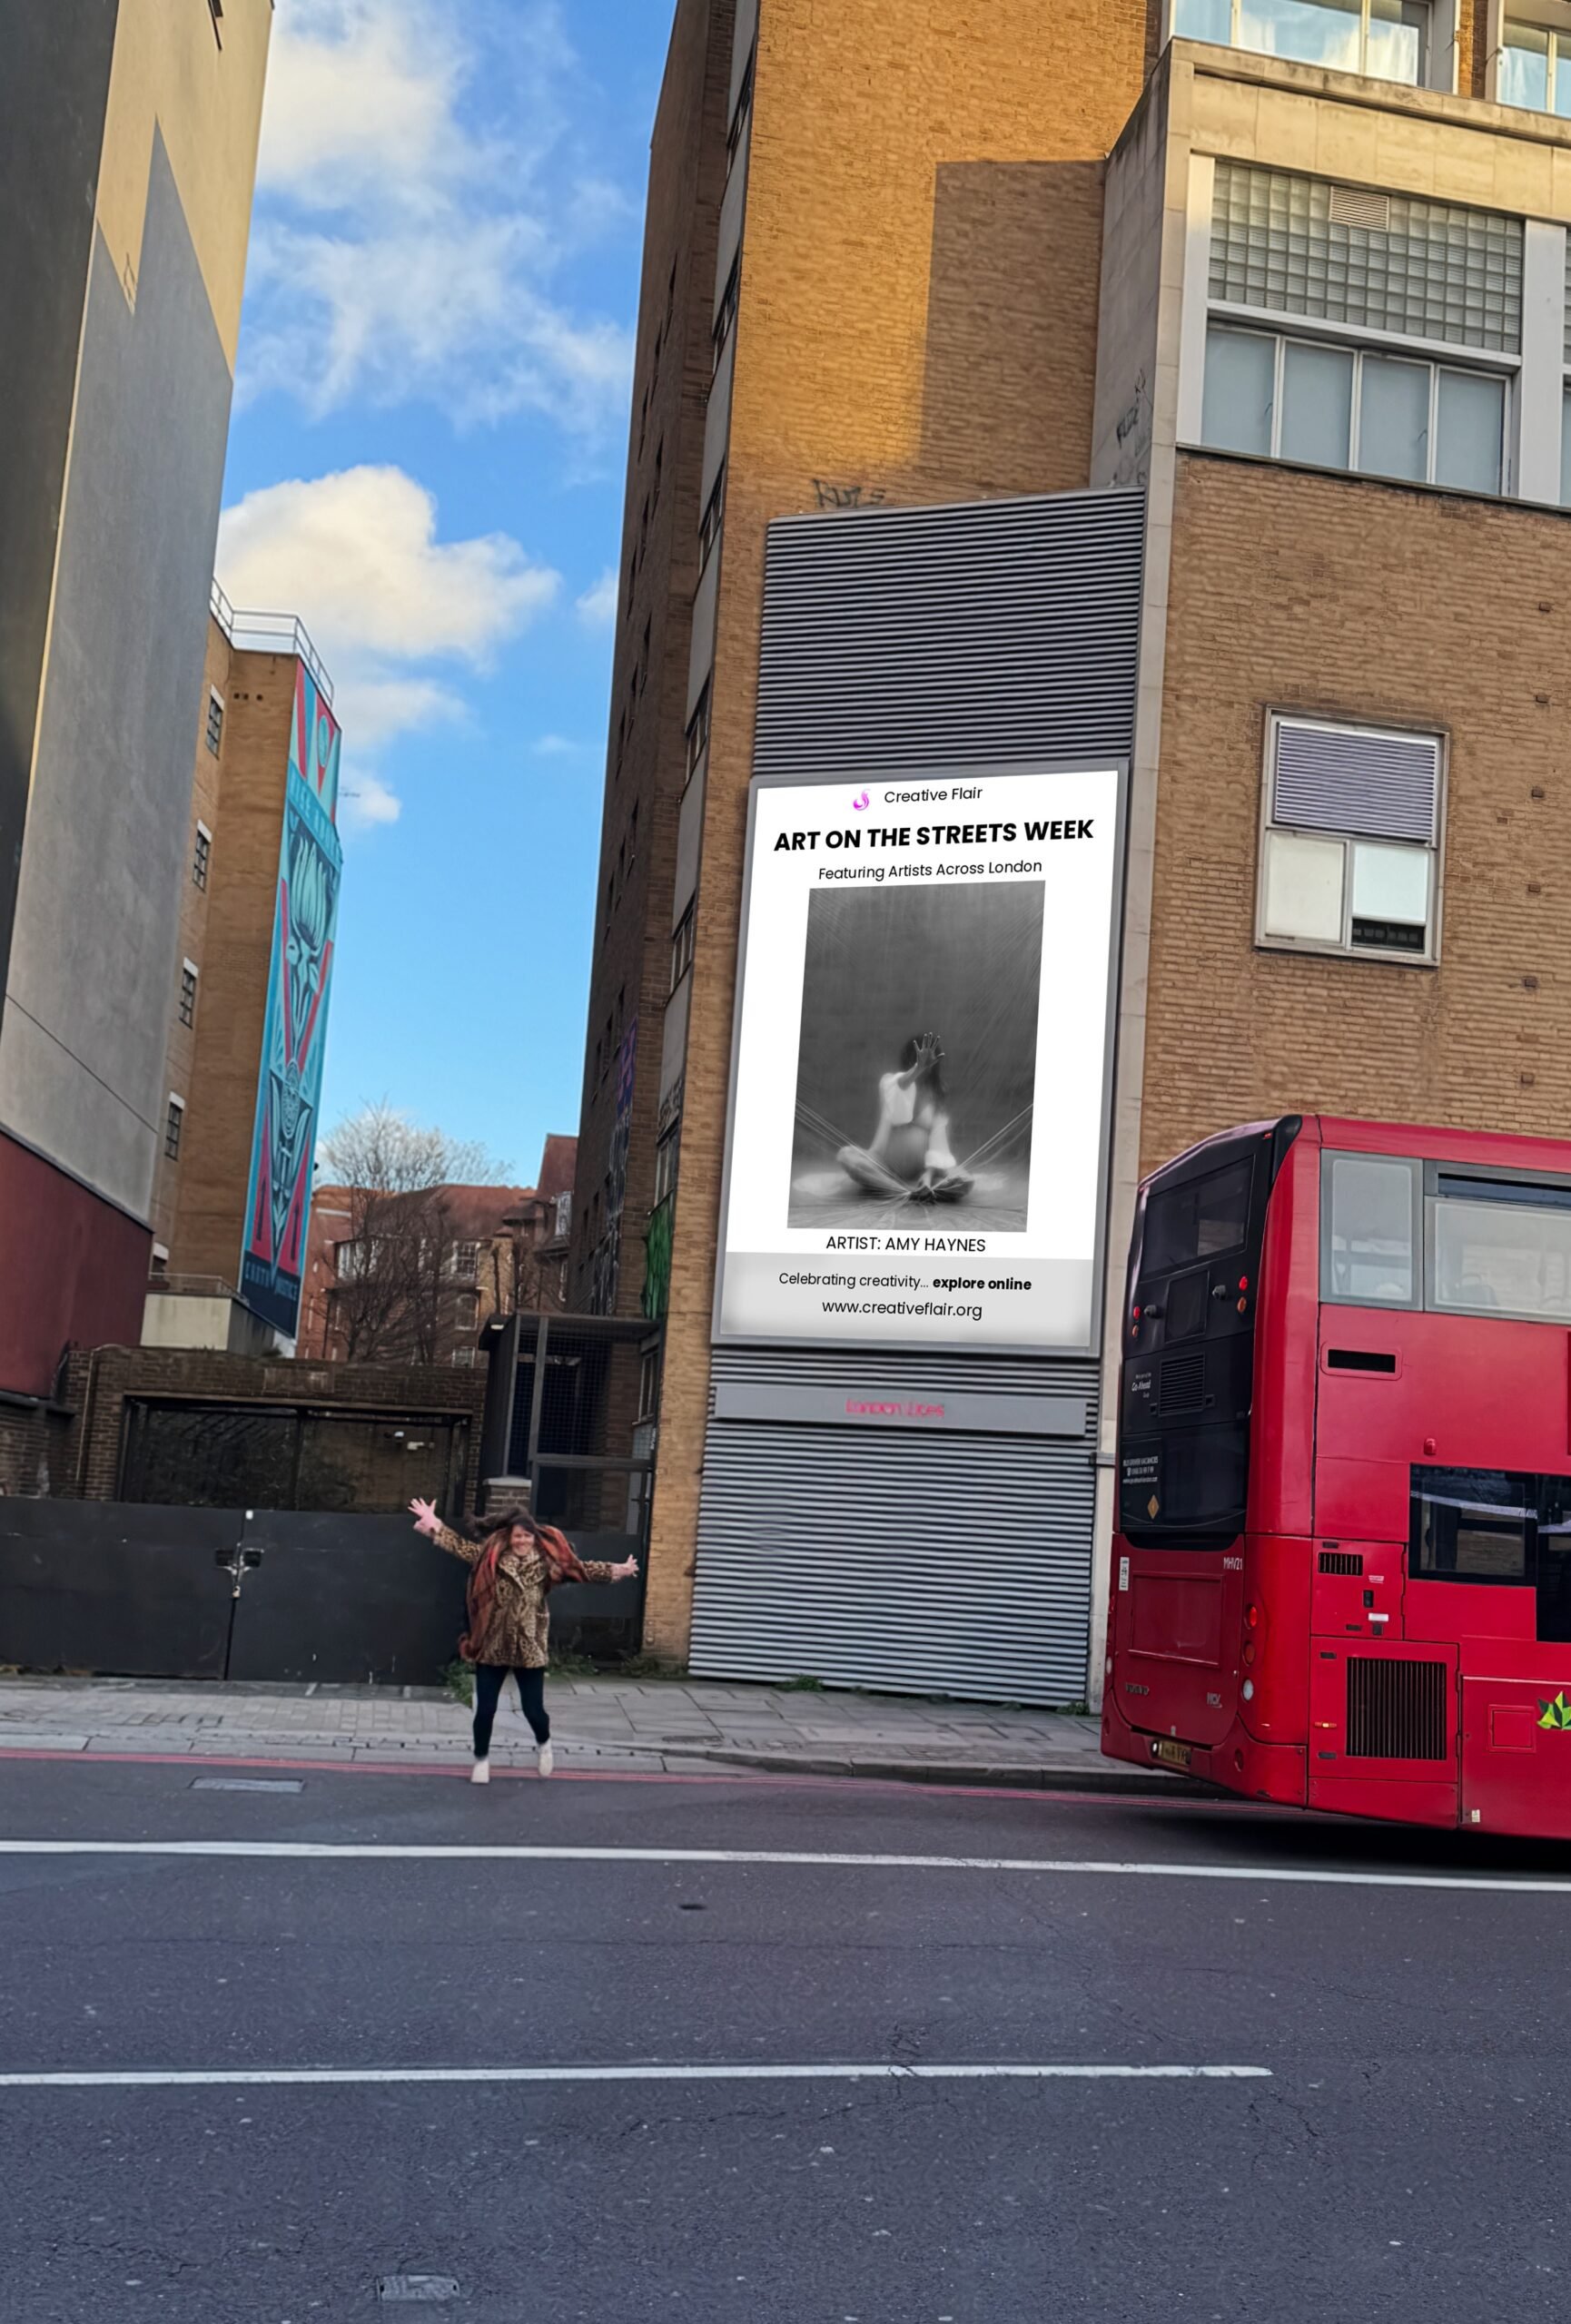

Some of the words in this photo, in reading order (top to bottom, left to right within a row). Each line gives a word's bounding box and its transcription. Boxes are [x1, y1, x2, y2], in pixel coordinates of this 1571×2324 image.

[884, 789, 948, 803] Creative
[952, 786, 983, 800] Flair
[773, 830, 821, 852] ART
[825, 828, 862, 849] ON
[866, 827, 911, 848] THE
[916, 822, 1017, 846] STREETS
[1023, 819, 1094, 841] WEEK
[818, 866, 885, 882] Featuring
[888, 864, 933, 878] Artists
[935, 863, 984, 876] Across
[988, 860, 1042, 874] London
[825, 1236, 881, 1250] ARTIST:
[884, 1236, 921, 1251] AMY
[924, 1237, 986, 1253] HAYNES
[778, 1272, 856, 1289] Celebrating
[859, 1275, 929, 1291] creativity...
[933, 1276, 985, 1293] explore
[988, 1276, 1033, 1291] online
[822, 1301, 983, 1322] www.creativeflair.org
